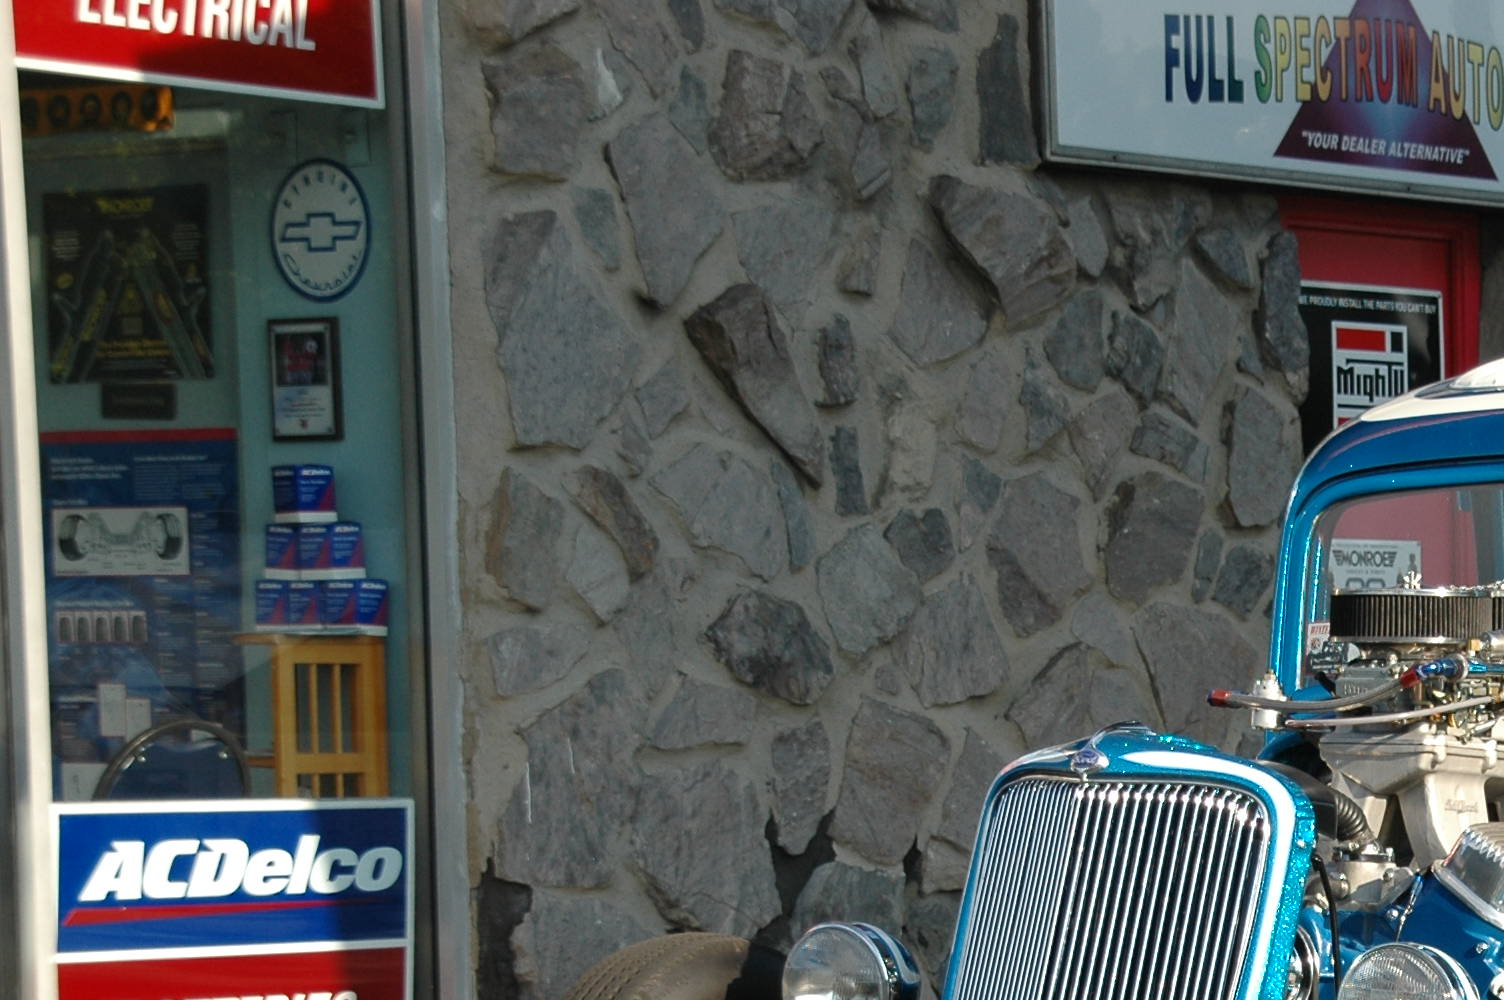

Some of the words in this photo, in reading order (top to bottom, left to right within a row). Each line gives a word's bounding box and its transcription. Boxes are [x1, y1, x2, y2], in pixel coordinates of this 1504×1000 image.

[1164, 14, 1243, 103] FULL
[1254, 15, 1418, 107] SPECTRUM
[1430, 31, 1504, 131] AUTO
[1301, 130, 1338, 152] "YOUR
[1341, 134, 1387, 158] DEALER
[1388, 139, 1470, 166] ALTERNATIVE"
[1338, 550, 1395, 568] MONROE
[79, 834, 404, 902] ACDelco
